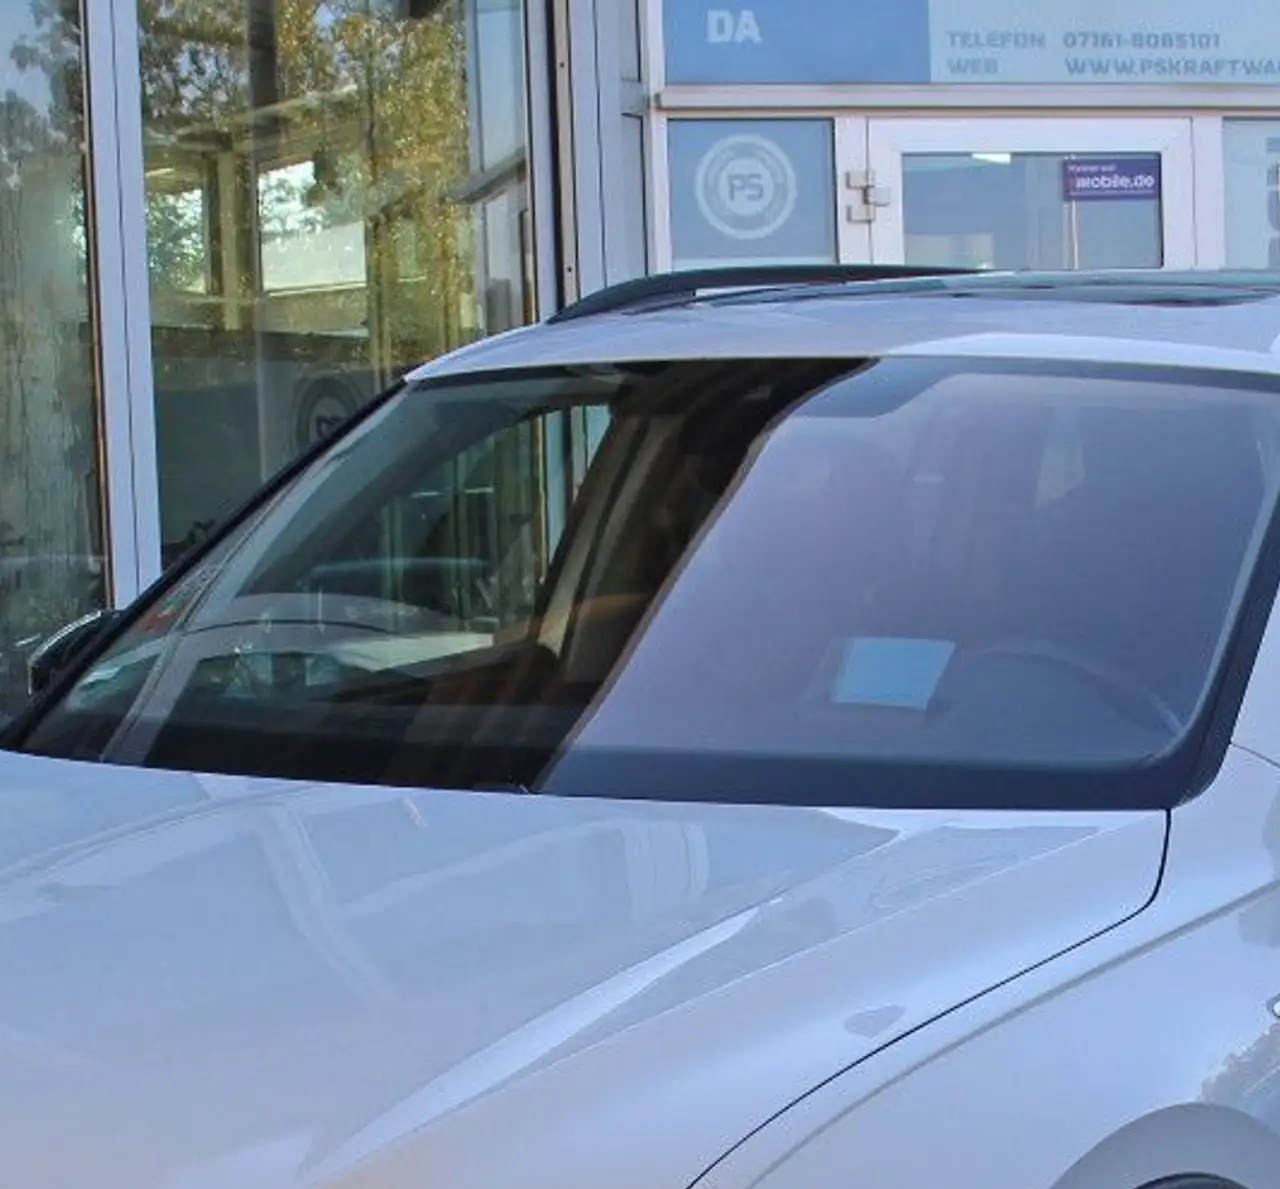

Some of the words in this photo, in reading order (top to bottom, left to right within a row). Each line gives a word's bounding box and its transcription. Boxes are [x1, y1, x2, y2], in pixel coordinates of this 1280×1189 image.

[706, 9, 762, 44] DA
[948, 31, 1046, 49] TELEFON
[948, 57, 999, 75] WEB
